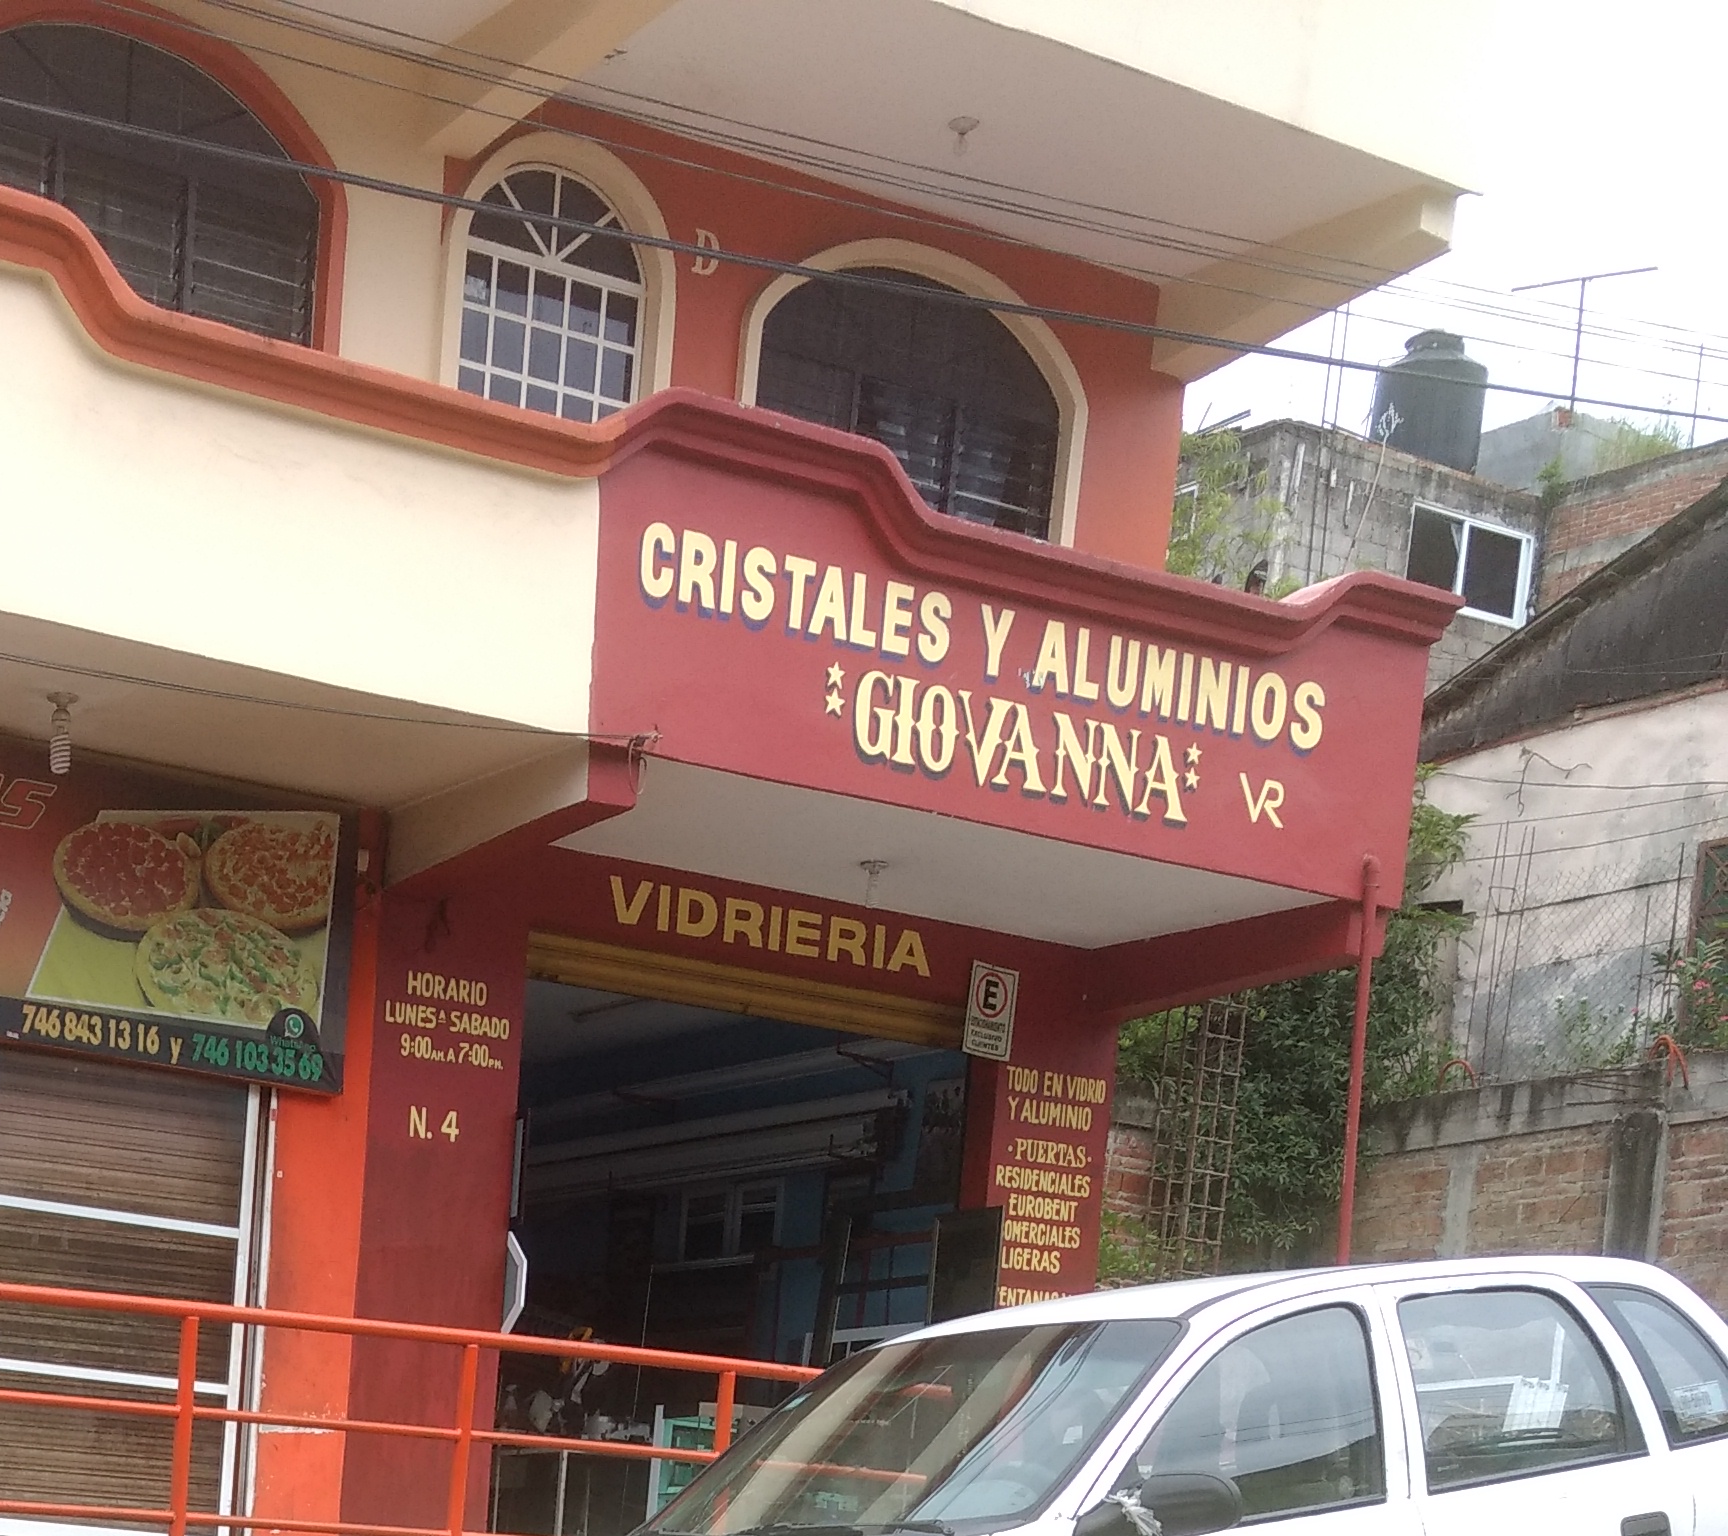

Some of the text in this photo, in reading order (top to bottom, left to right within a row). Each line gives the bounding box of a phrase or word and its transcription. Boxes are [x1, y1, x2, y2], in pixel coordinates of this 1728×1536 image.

[638, 521, 1326, 753] CRISTALES Y ALUMINIOS
[854, 670, 1188, 828] GIOVANNA
[1238, 771, 1285, 829] VR
[608, 874, 931, 978] VIDRIERIA
[407, 970, 487, 1007] HORARIO
[982, 978, 1000, 1012] E
[385, 999, 437, 1029] LUNES
[449, 1010, 510, 1040] SABADO
[22, 1003, 62, 1036] 746
[63, 1010, 103, 1046] 843
[107, 1019, 131, 1050] 13
[136, 1022, 161, 1056] 16
[191, 1033, 230, 1067] 746
[234, 1040, 269, 1074] 103
[271, 1046, 296, 1078] 35
[298, 1053, 323, 1082] 69
[1006, 1065, 1107, 1105] TODO EN VIDRIO
[440, 1110, 460, 1143] 4
[1007, 1095, 1092, 1132] Y ALUMINIO
[995, 1164, 1091, 1199] RESIDENCIALES
[1008, 1192, 1079, 1223] EUROBENT
[1003, 1218, 1081, 1250] OMERCIALES
[1001, 1244, 1061, 1275] LIGERAS
